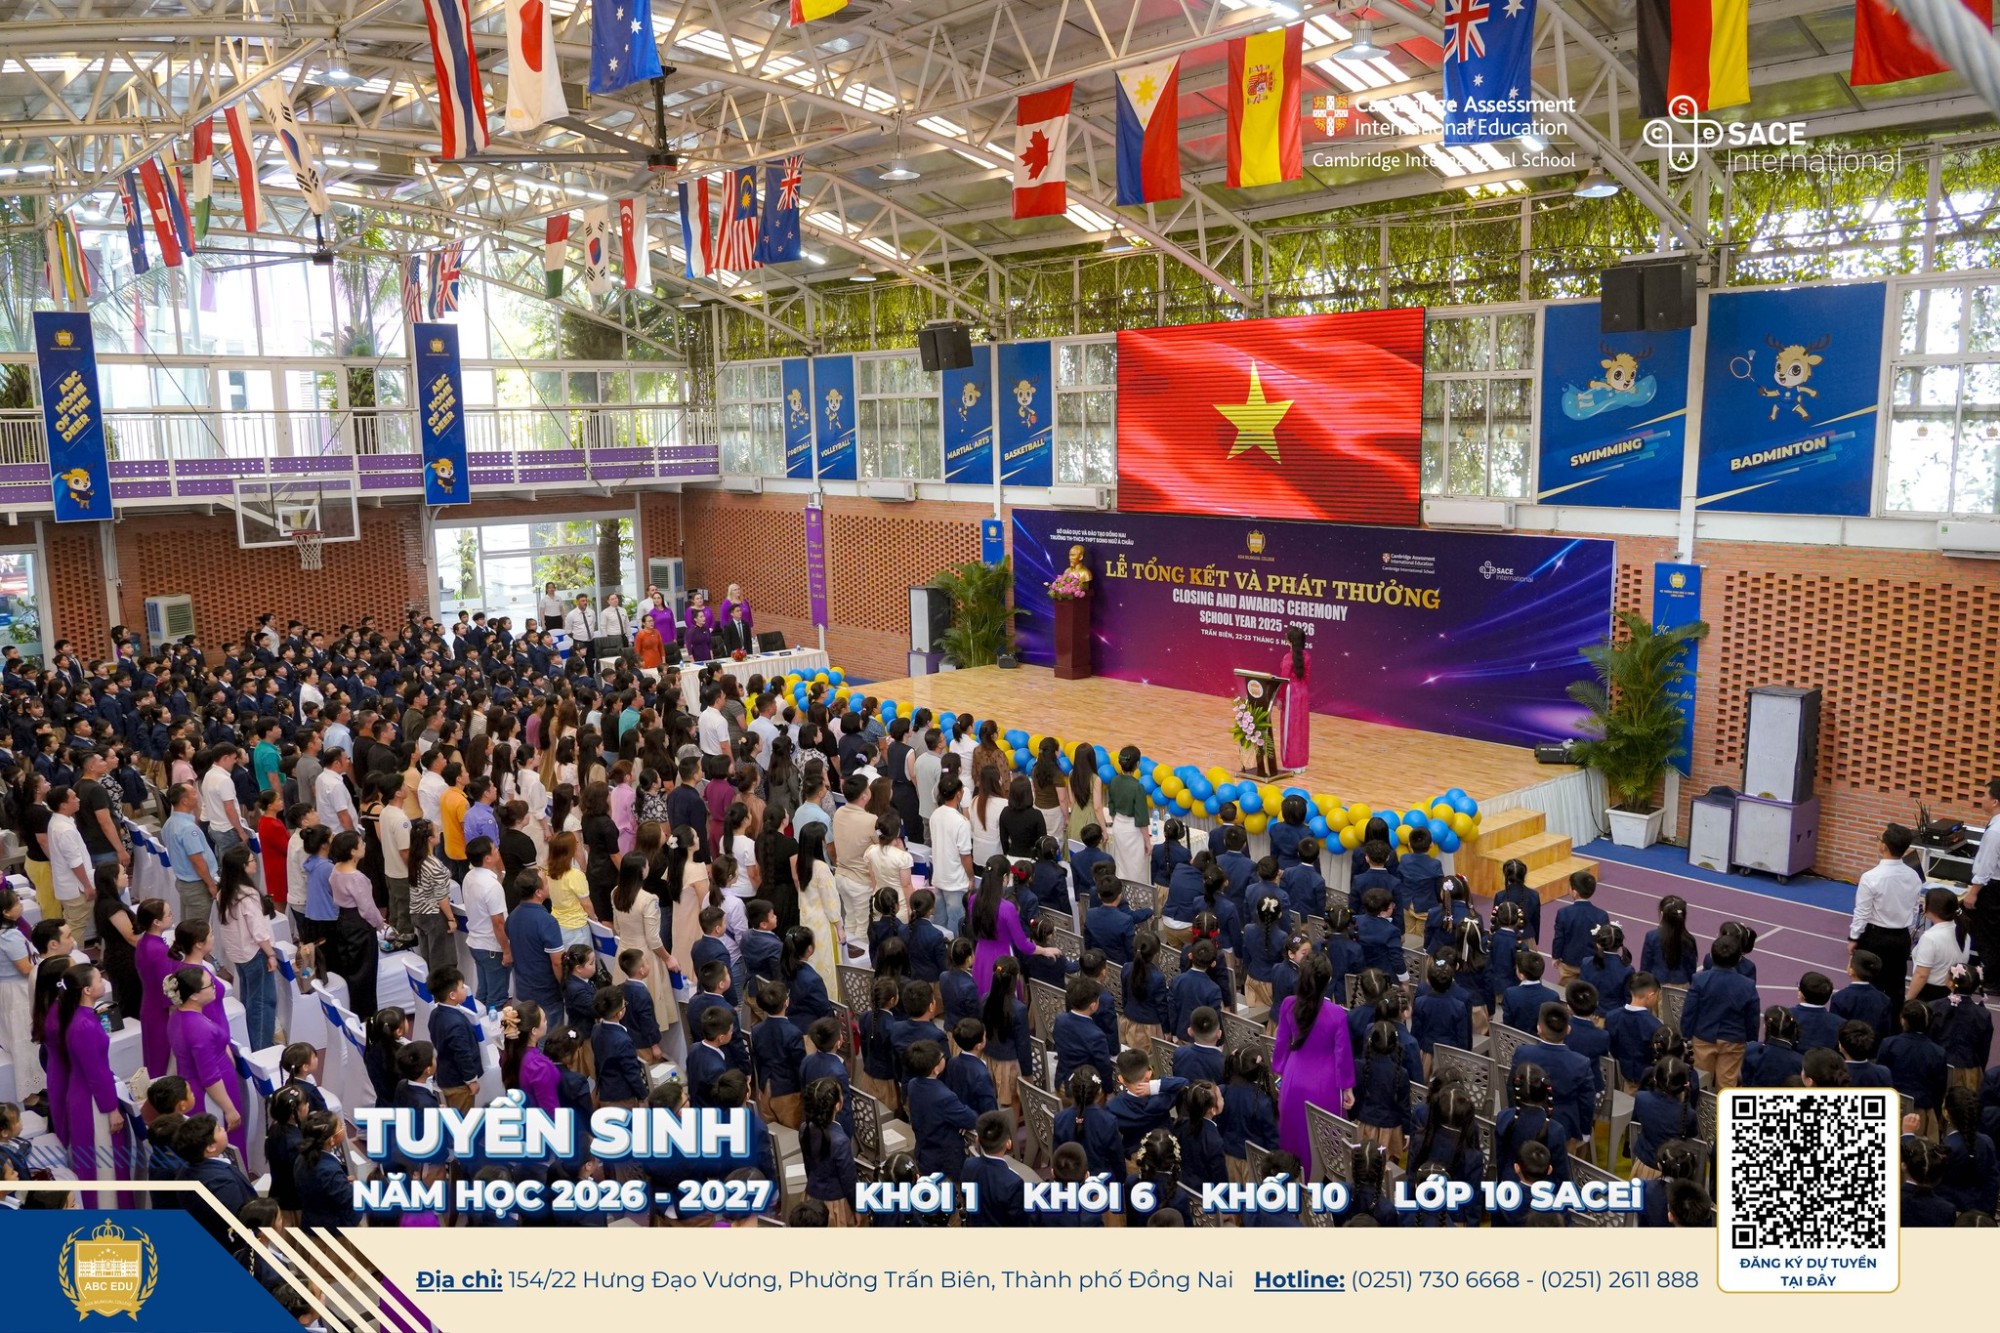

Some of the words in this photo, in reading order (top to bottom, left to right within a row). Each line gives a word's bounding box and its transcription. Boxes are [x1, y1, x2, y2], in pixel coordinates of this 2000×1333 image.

[59, 370, 82, 396] ABC
[432, 373, 450, 395] ABC
[55, 382, 87, 415] HOME
[428, 383, 454, 412] HOME
[55, 414, 71, 432] OF
[68, 395, 92, 418] THE
[427, 412, 440, 428] OF
[438, 394, 456, 413] THE
[432, 411, 455, 436] DEER
[61, 413, 91, 443] DEER
[787, 441, 811, 458] FOOTBALL
[820, 438, 851, 458] VOLLEYBALL
[947, 444, 973, 460] MARTIAL
[973, 435, 990, 449] ARTS
[1004, 438, 1046, 461] BASKETBALL
[1570, 437, 1643, 468] SWIMMING
[1730, 436, 1827, 471] BADMINTON
[1105, 553, 1128, 579] LỄ
[1132, 556, 1186, 584] TỔNG
[1189, 563, 1230, 588] KẾT
[1234, 568, 1262, 592] VÀ
[1266, 573, 1327, 598] PHÁT
[1332, 579, 1441, 610] THƯỞNG
[1496, 567, 1514, 575] SACE
[1173, 588, 1215, 606] CLOSING
[1216, 592, 1237, 609] AND
[1239, 595, 1285, 614] AWARDS
[1287, 600, 1348, 621] CEREMONY
[1200, 610, 1234, 626] SCHOOL
[1235, 614, 1257, 630] YEAR
[1258, 617, 1282, 632] 2025
[1235, 633, 1251, 641] 22-23
[1253, 635, 1274, 644] THÁNG
